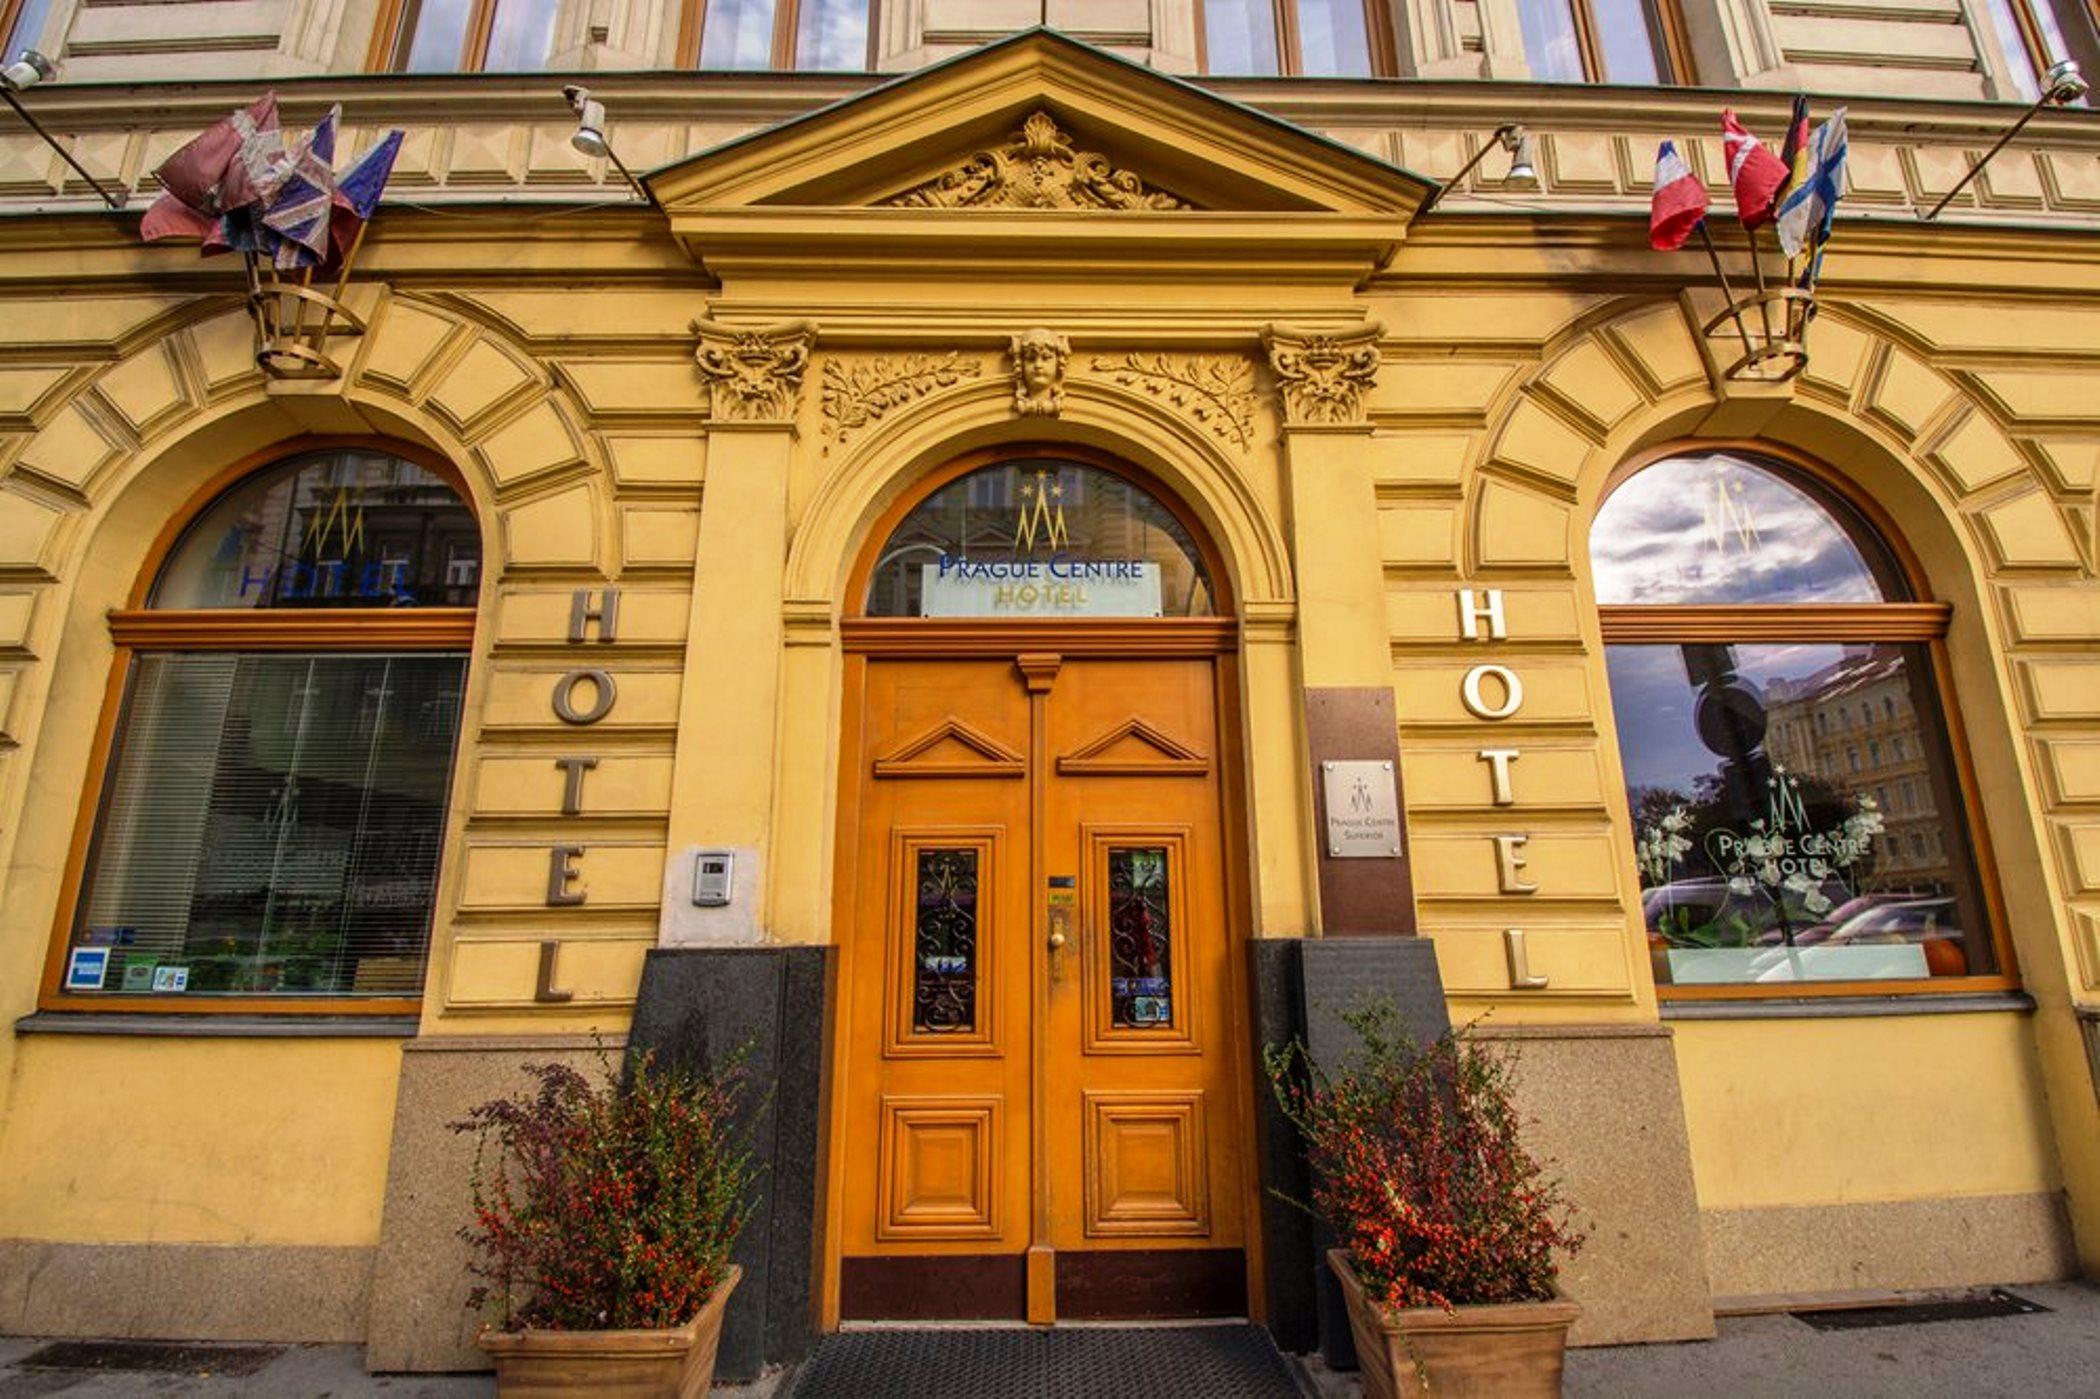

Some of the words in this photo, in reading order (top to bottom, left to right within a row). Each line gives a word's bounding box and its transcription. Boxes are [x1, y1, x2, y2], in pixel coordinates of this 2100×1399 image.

[939, 553, 1038, 578] PRAGUE
[1048, 553, 1142, 578] CENTRE
[997, 585, 1088, 605] HOTEL
[535, 587, 621, 1001] HOTEL
[1454, 588, 1549, 991] HOTEL
